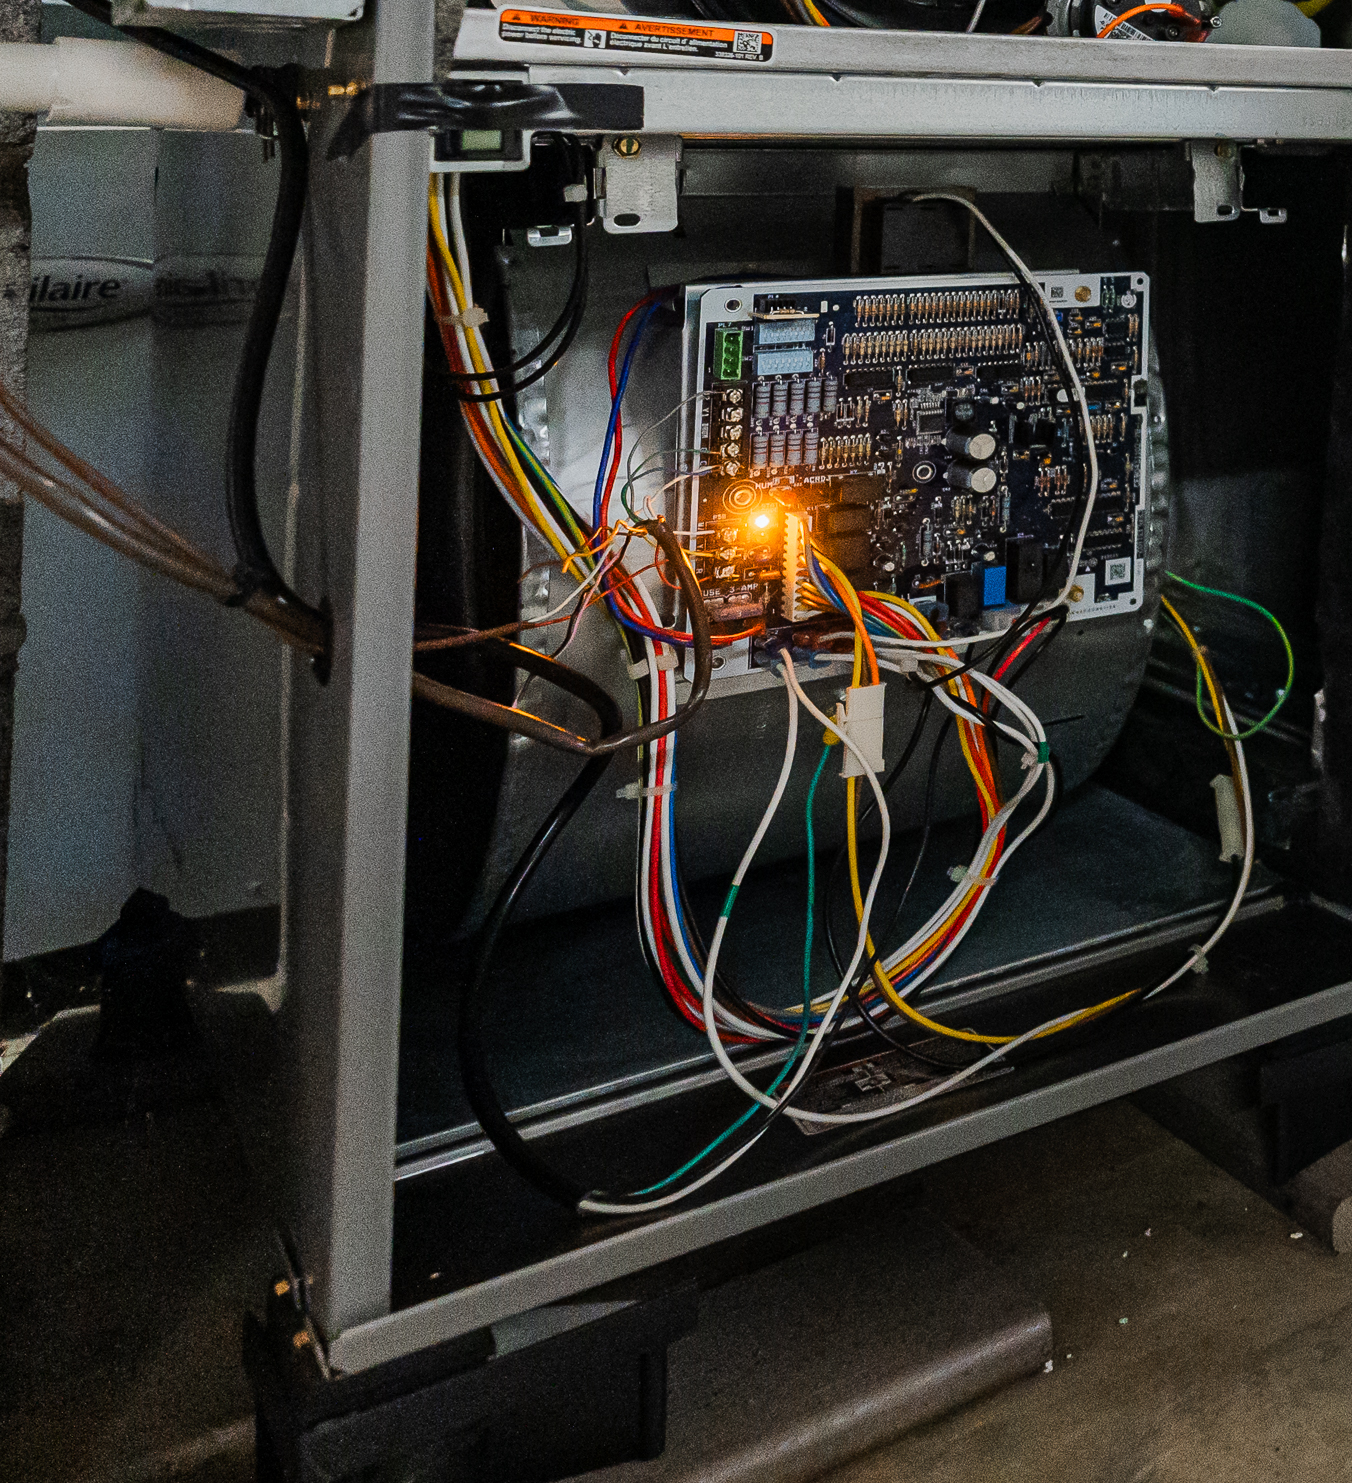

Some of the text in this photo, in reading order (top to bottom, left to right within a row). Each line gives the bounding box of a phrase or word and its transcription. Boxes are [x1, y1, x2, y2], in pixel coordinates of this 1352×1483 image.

[530, 14, 579, 26] WARNING
[635, 23, 714, 37] AVERTISSEMENT
[29, 275, 121, 303] ilaire
[703, 589, 720, 597] USE
